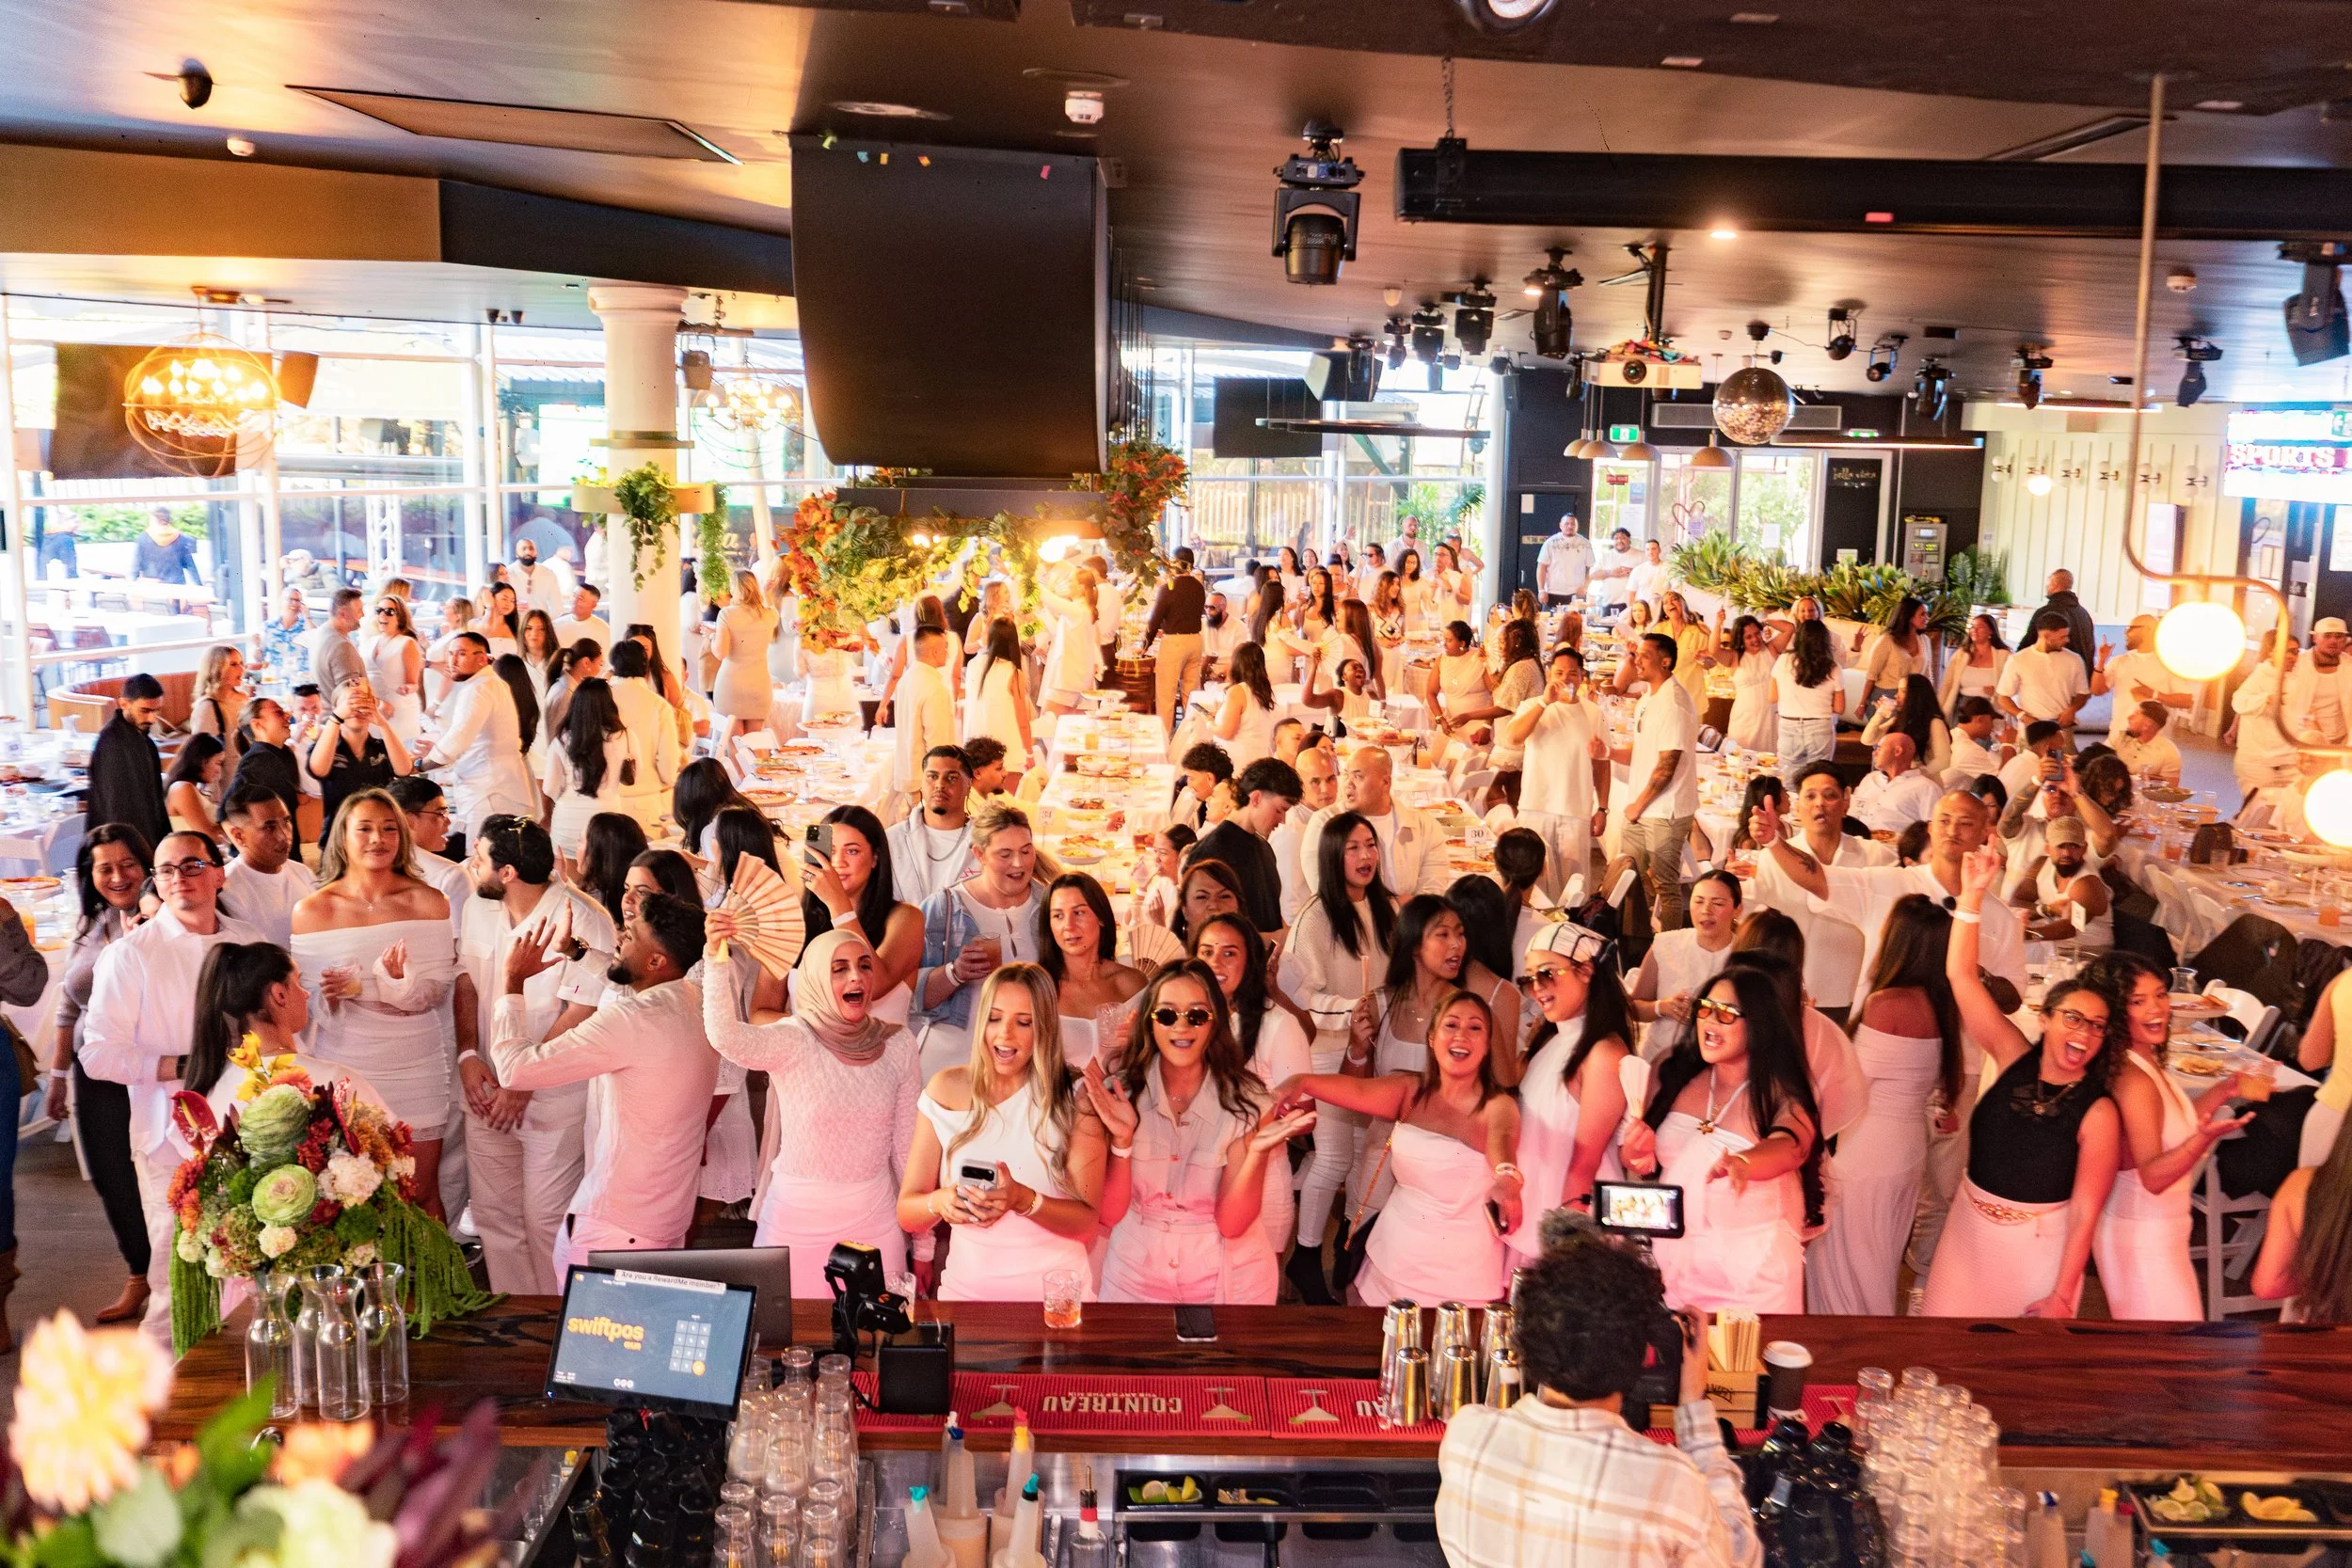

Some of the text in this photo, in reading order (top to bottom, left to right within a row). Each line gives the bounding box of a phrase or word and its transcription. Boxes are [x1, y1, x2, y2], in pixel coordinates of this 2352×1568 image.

[2230, 446, 2335, 467] SPORTS
[1470, 830, 1484, 838] 30
[621, 1271, 633, 1279] Are
[689, 1280, 721, 1290] member?
[567, 1317, 644, 1342] swiftpos
[1042, 1396, 1183, 1413] COINTREAU
